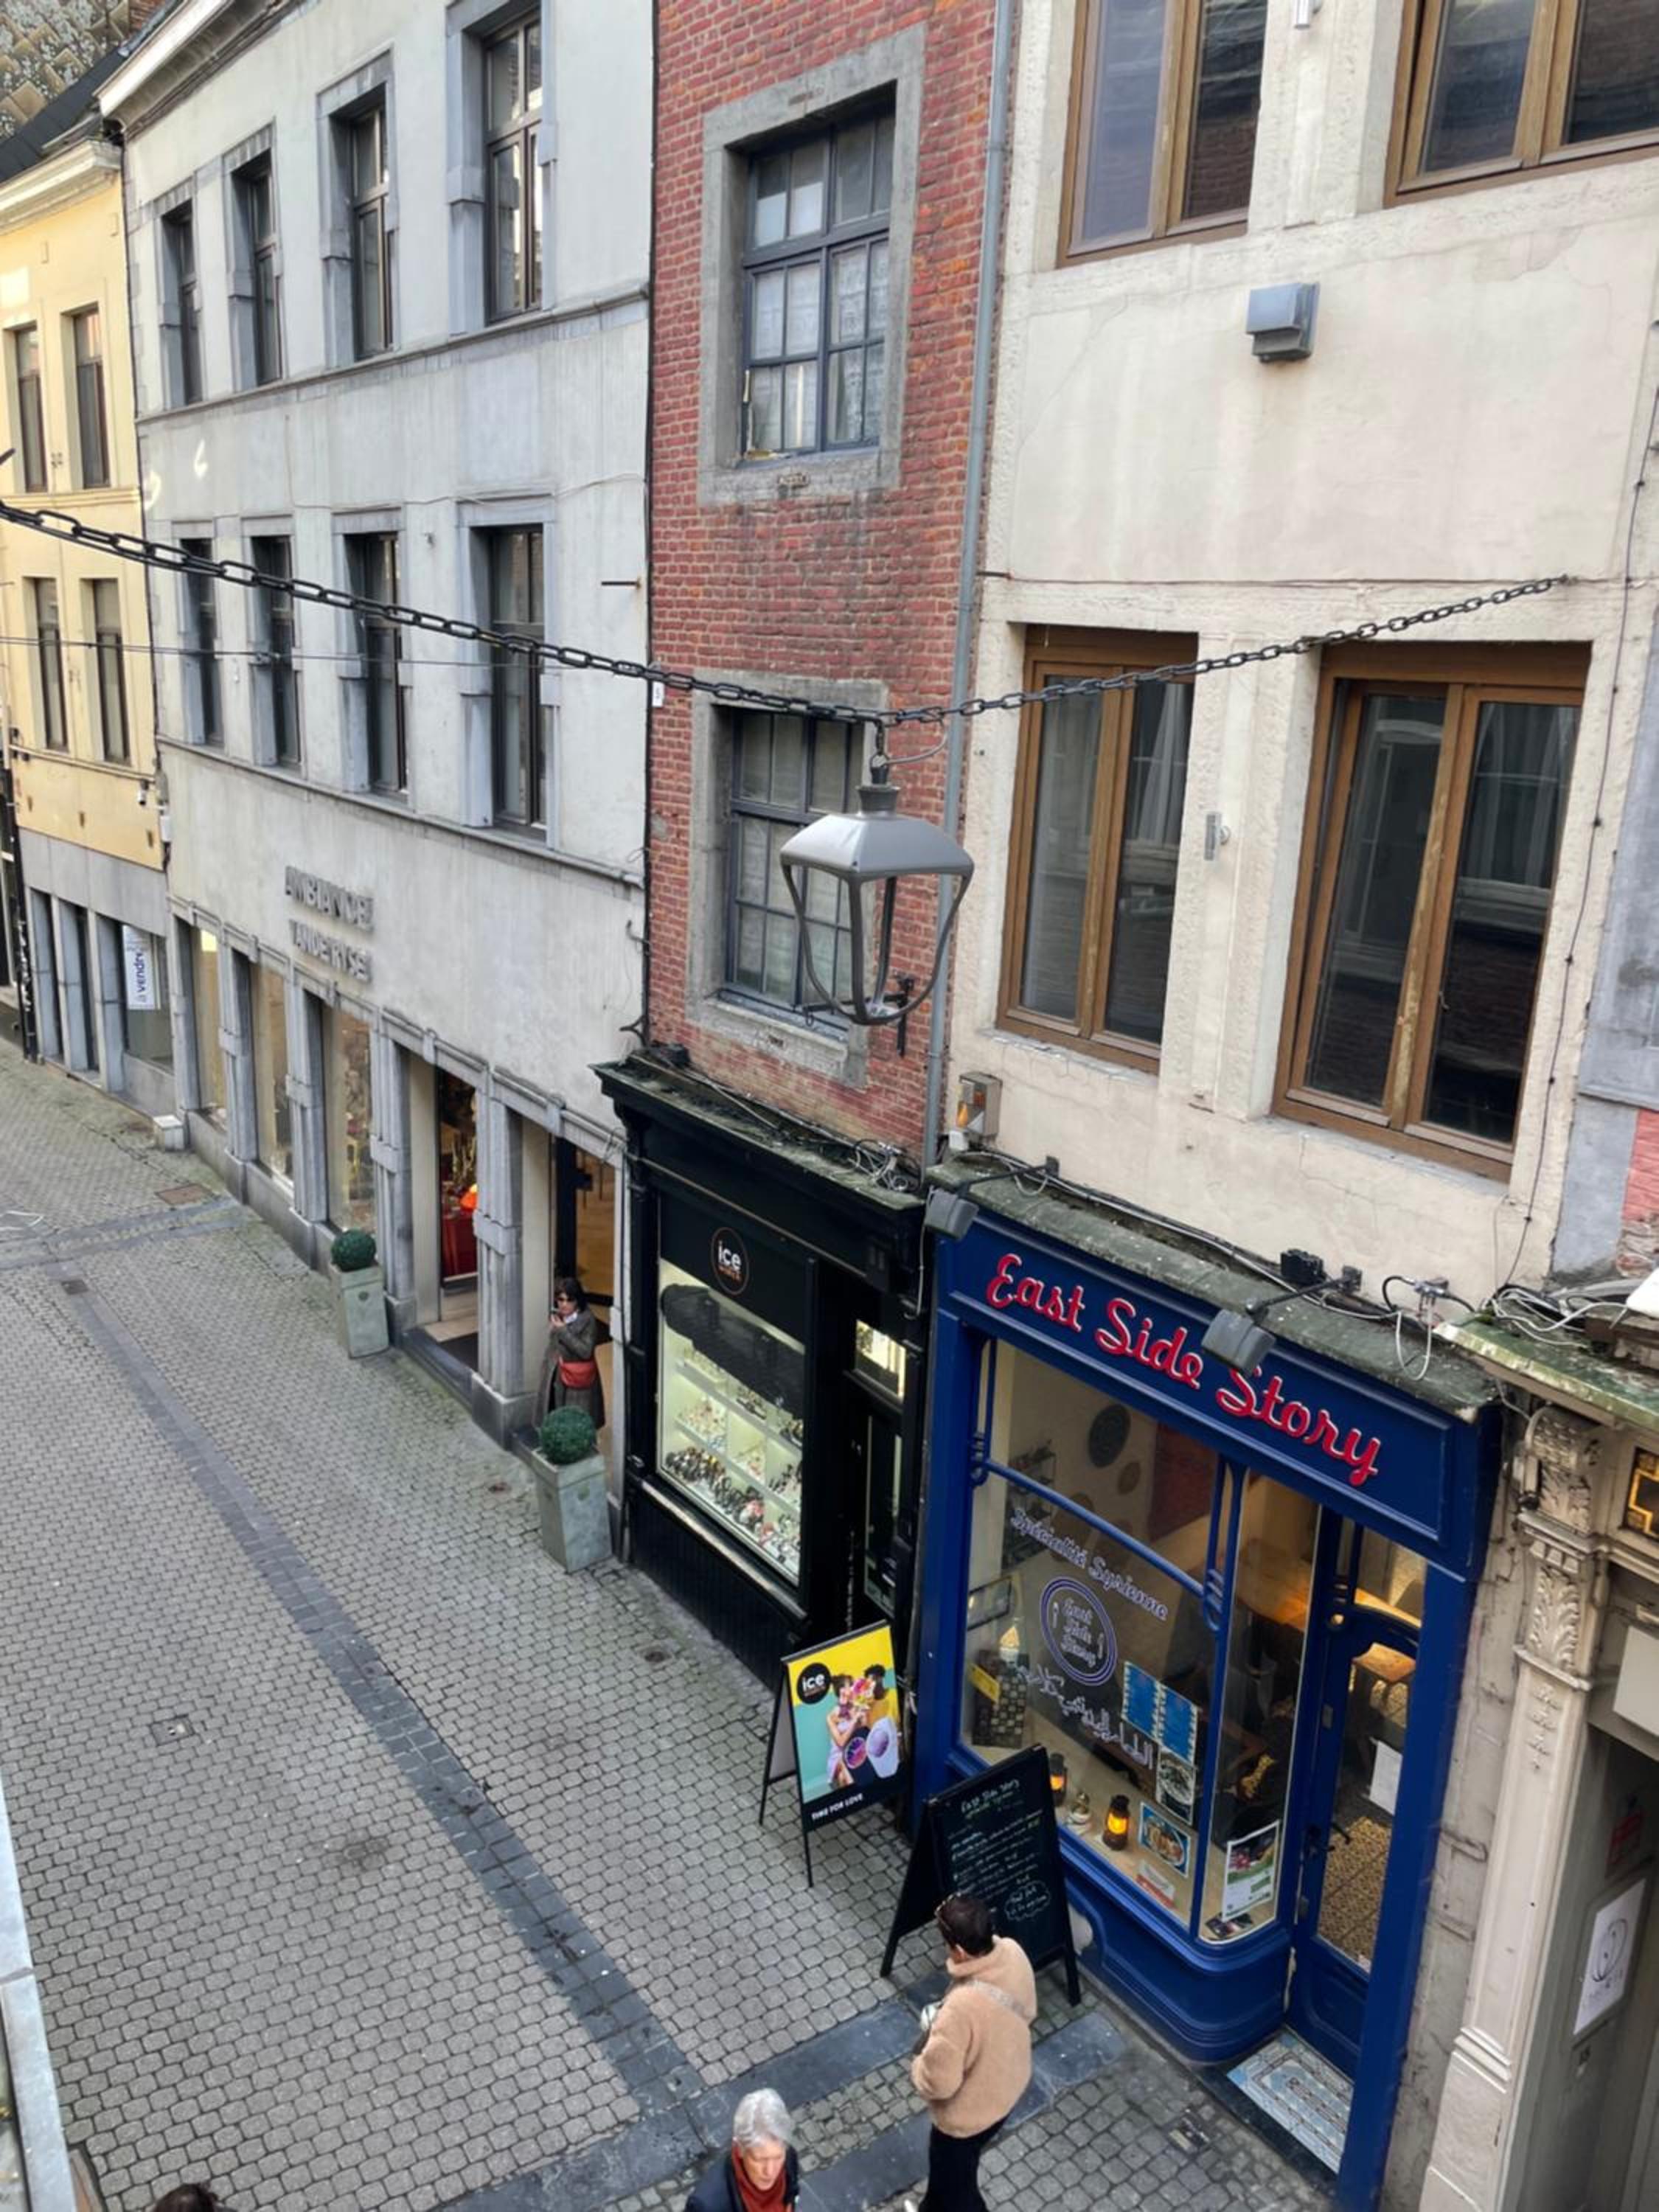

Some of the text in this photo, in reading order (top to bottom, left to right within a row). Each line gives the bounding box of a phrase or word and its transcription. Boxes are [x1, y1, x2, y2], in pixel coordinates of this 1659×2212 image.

[285, 866, 374, 931] AMBIANCE
[717, 1240, 742, 1271] ice
[985, 1252, 1382, 1486] East Side Story
[1088, 1556, 1169, 1621] Syrienne
[801, 1672, 826, 1694] ice
[829, 1801, 844, 1813] FOR
[844, 1792, 863, 1807] LOVE
